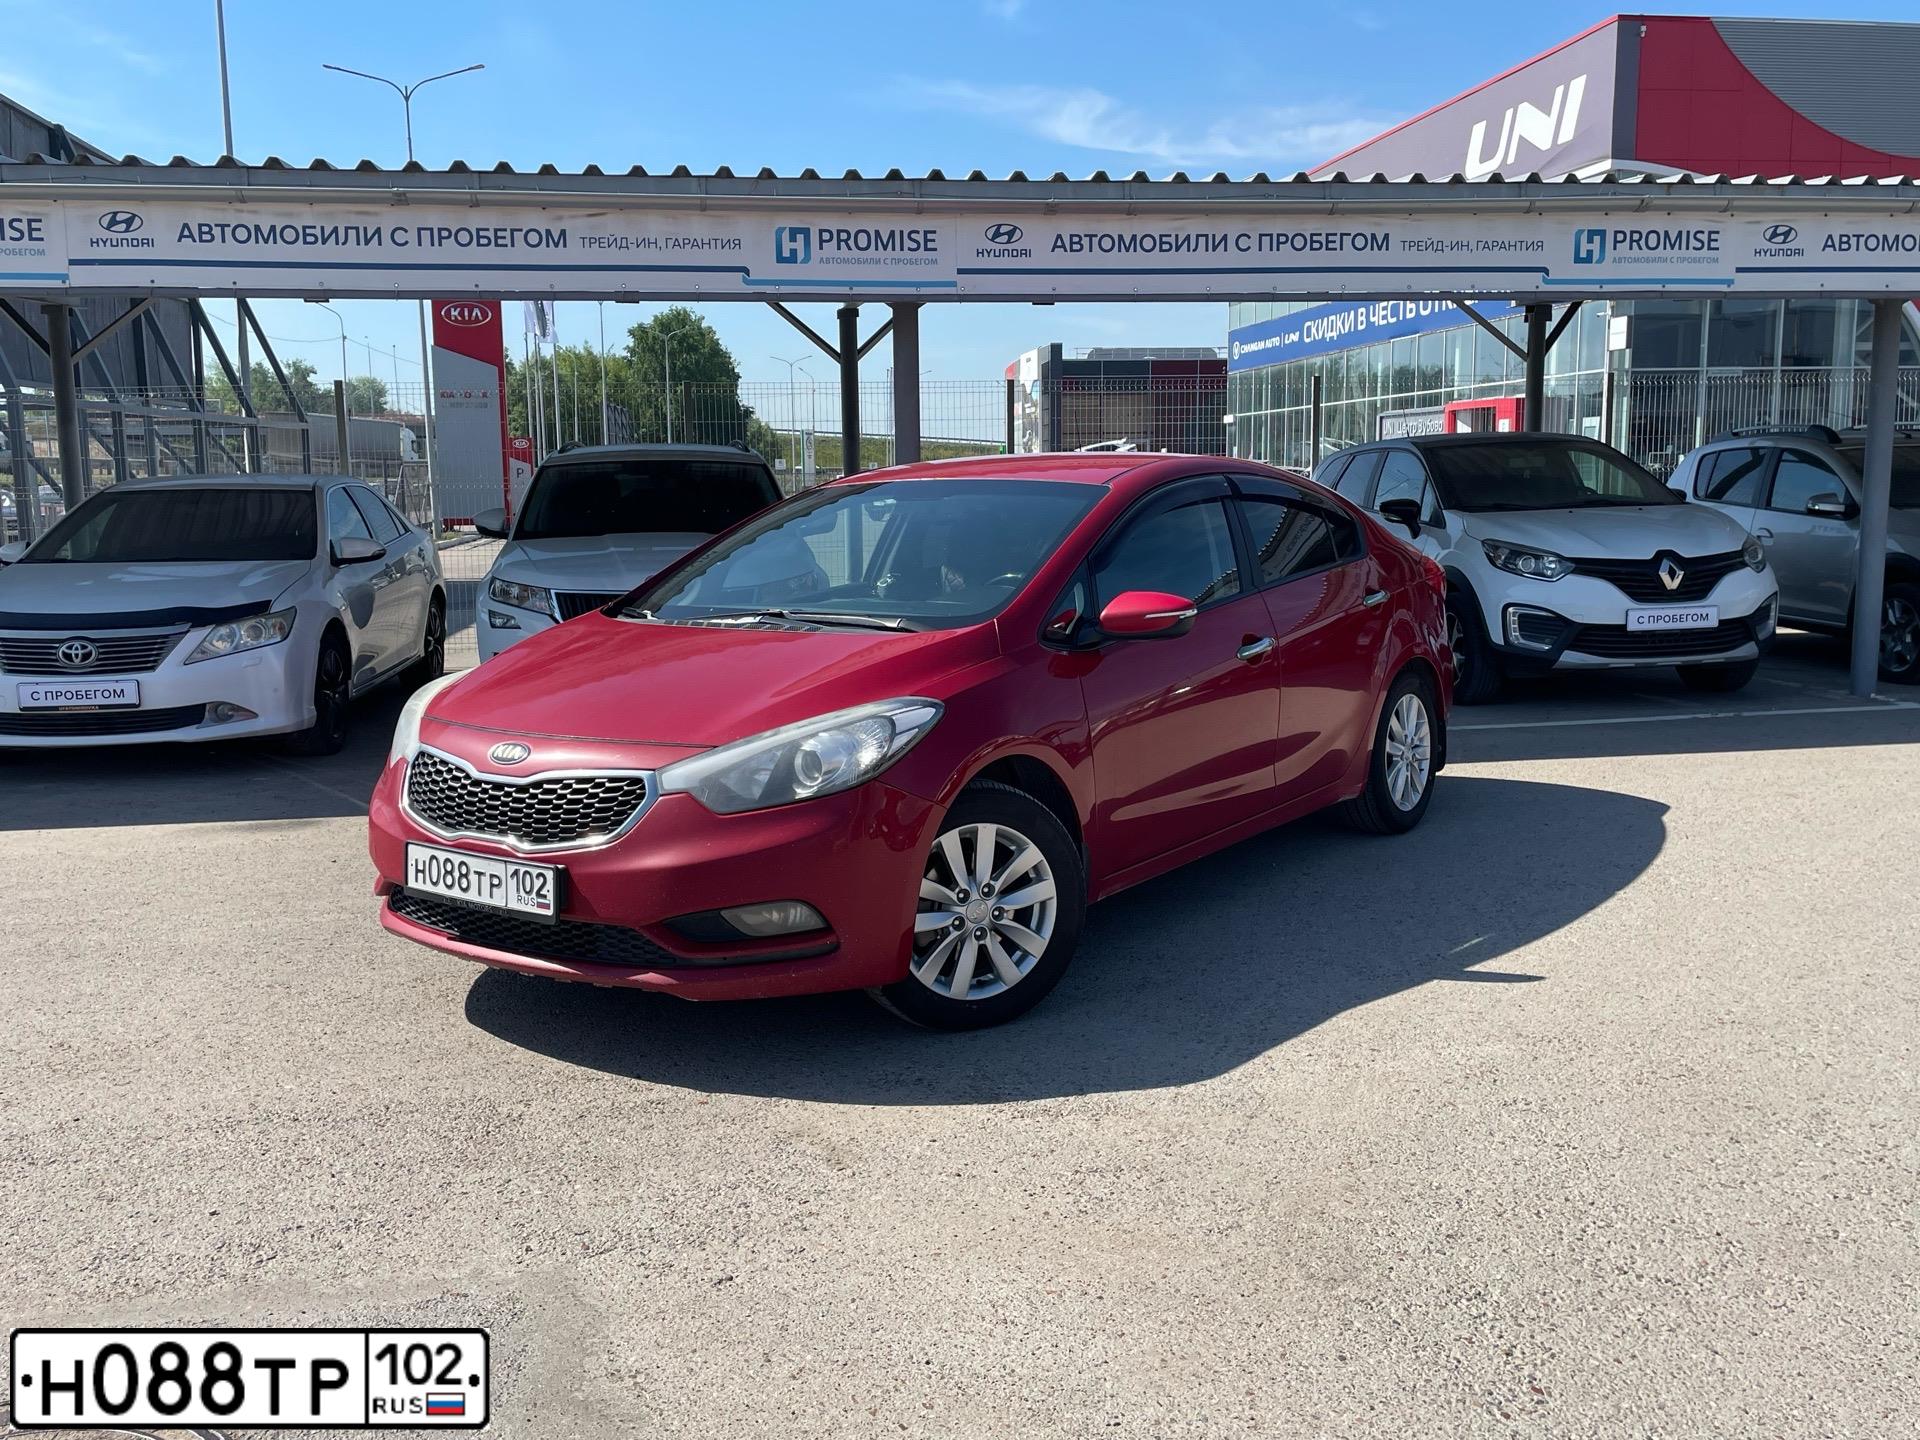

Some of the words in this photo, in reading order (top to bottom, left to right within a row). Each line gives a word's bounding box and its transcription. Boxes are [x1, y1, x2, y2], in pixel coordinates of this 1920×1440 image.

[1464, 74, 1587, 180] UNI
[90, 237, 155, 248] HYUNDAI
[177, 222, 383, 247] АВТОМОБИЛИ
[390, 226, 410, 247] С
[416, 227, 568, 249] ПРОБЕГОМ
[579, 234, 662, 252] ТРЕЙД-ИН,
[665, 236, 742, 251] ГАРАНТИЯ
[818, 228, 938, 252] PROMISE
[1050, 233, 1228, 253] АВТОМОБИЛИ
[1234, 233, 1252, 252] С
[1258, 232, 1390, 252] ПРОБЕГОМ
[1612, 229, 1720, 252] PROMISE
[1821, 233, 1920, 252] АВТОМО
[976, 248, 1032, 258] HYUNDAI
[1399, 237, 1473, 254] ТРЕЙД-ИН,
[1476, 239, 1544, 252] ГАРАНТИЯ
[1754, 248, 1805, 257] HYUNDAI
[819, 256, 881, 266] АВТОМОБИЛИ
[883, 257, 889, 266] С
[890, 257, 938, 266] ПРОБЕГОМ
[1612, 256, 1668, 265] АВТОМОБИЛИ
[1669, 256, 1675, 264] С
[1676, 256, 1720, 265] ПРОБЕГОМ
[450, 307, 484, 321] KIA
[1303, 310, 1355, 343] СКИДКИ
[1357, 307, 1367, 331] В
[1370, 300, 1416, 327] ЧЕСТЬ
[1636, 615, 1645, 625] С
[1647, 612, 1709, 625] ПРОБЕГОМ
[30, 691, 41, 701] С
[44, 688, 126, 701] ПРОБЕГОМ
[493, 744, 524, 760] KIA
[414, 854, 503, 900] Н088ТР
[509, 868, 548, 899] 102
[516, 894, 536, 907] RUS
